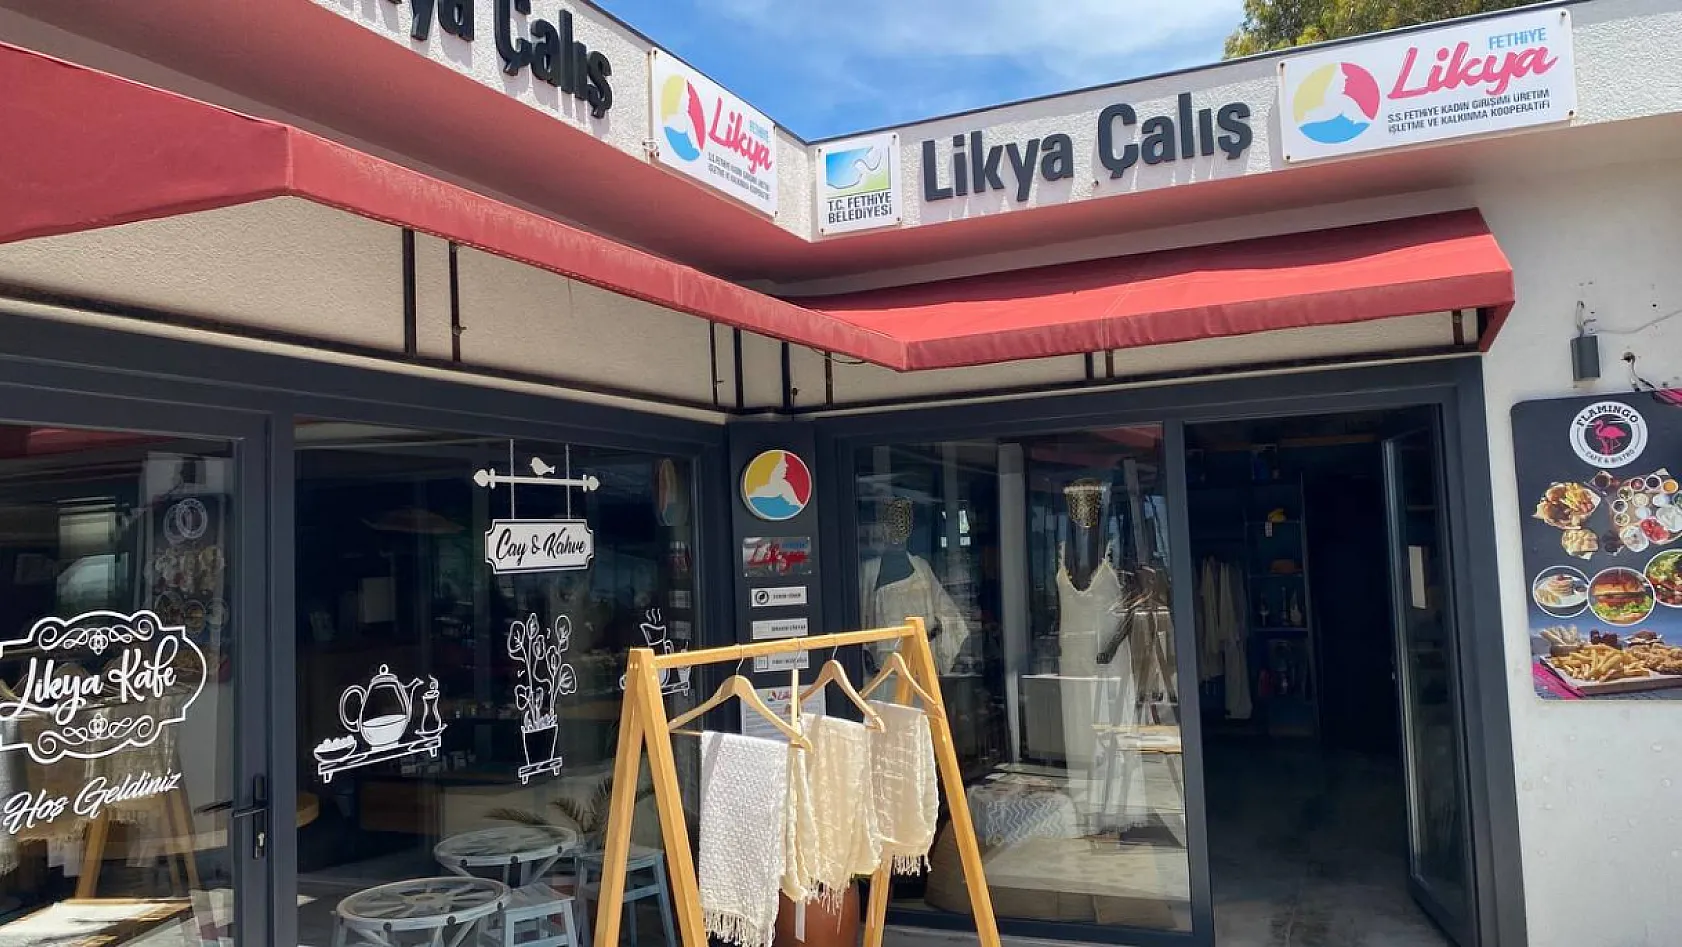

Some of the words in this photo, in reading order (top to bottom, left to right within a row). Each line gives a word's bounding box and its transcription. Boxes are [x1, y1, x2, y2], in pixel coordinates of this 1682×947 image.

[493, 0, 612, 119] Çalış
[1387, 41, 1558, 99] Likya
[708, 97, 772, 174] Likya
[922, 130, 1074, 202] Likya
[1098, 92, 1253, 178] Çalış
[1427, 117, 1439, 127] VE
[827, 199, 844, 212] T.C.
[1577, 405, 1638, 427] FLAMINGO
[532, 534, 541, 554] &
[543, 527, 586, 559] Kahve
[0, 657, 104, 725] Likya
[3, 788, 68, 834] Hoş
[73, 768, 182, 819] Geldiniz
